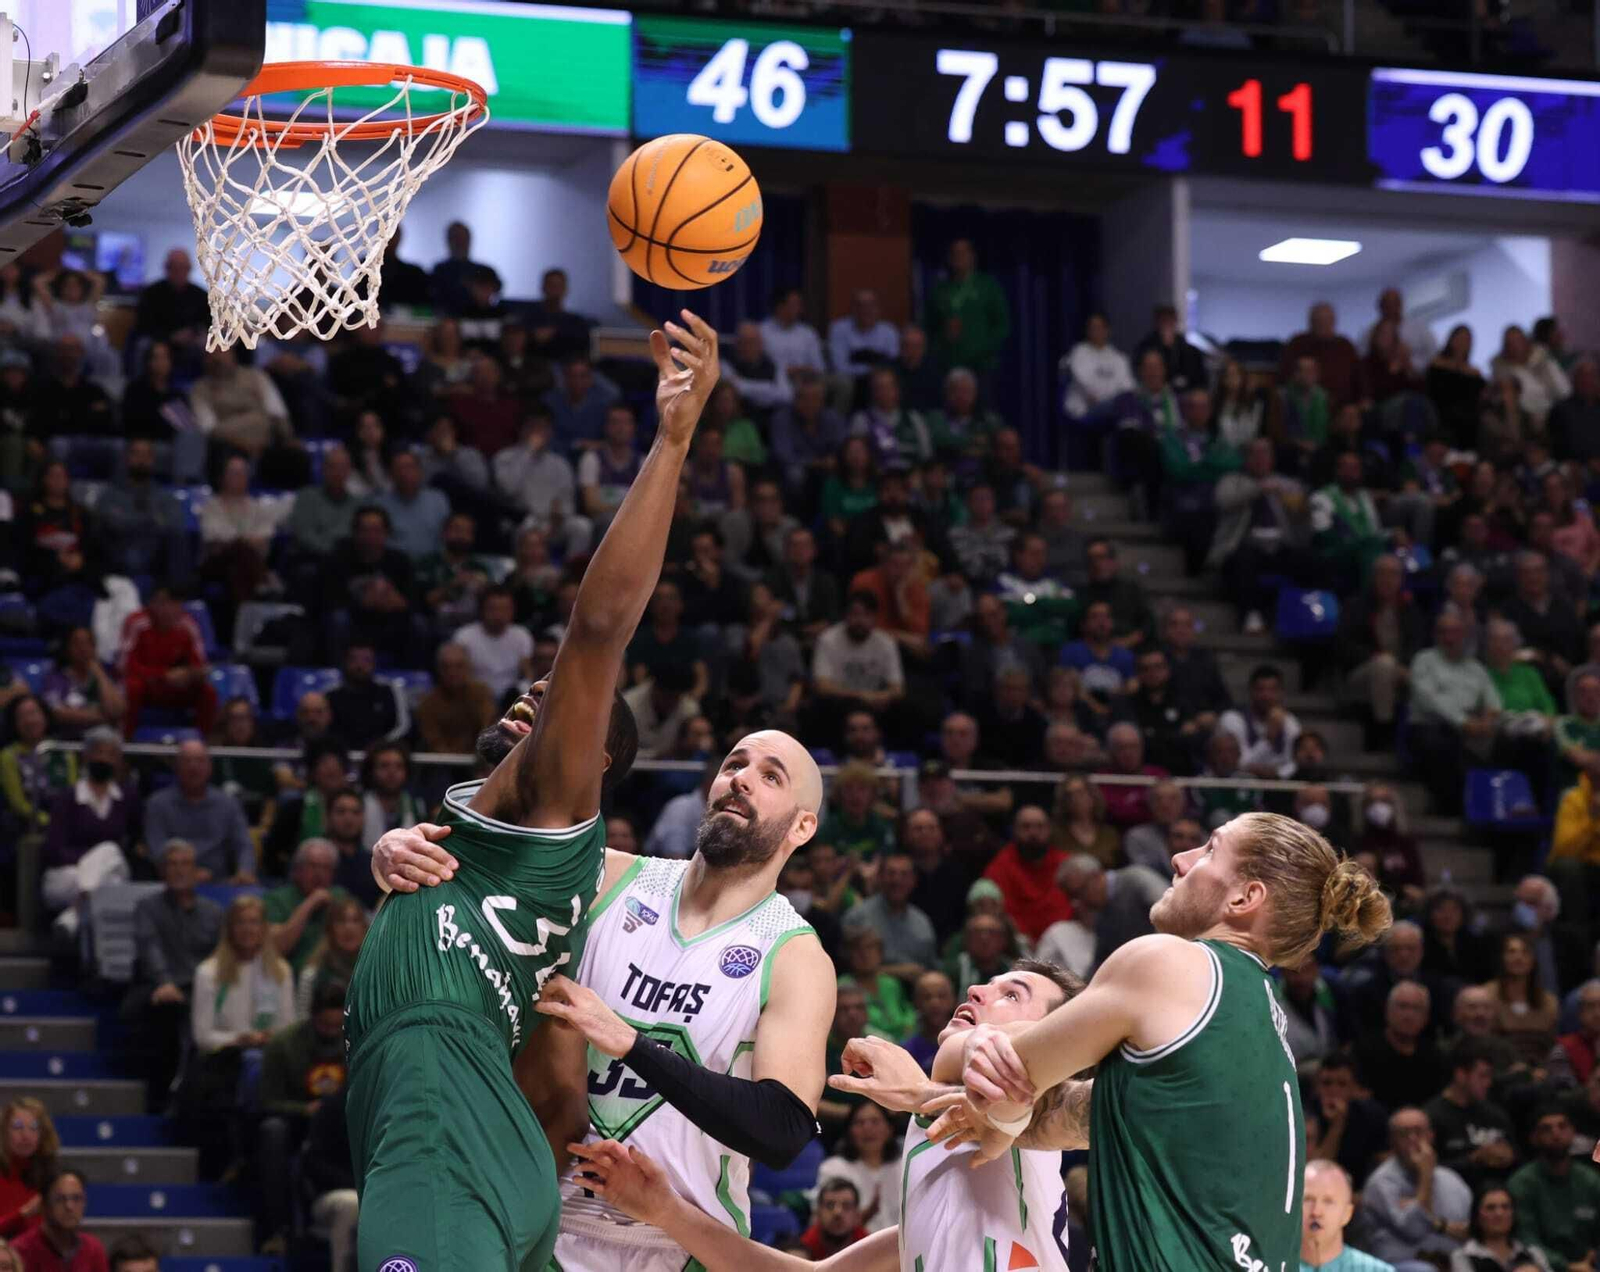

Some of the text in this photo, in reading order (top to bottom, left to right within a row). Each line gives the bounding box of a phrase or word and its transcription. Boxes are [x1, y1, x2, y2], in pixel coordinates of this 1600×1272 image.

[686, 38, 809, 130] 46
[936, 49, 1157, 154] 7:57
[1227, 78, 1314, 162] 11
[1420, 92, 1534, 183] 30
[620, 962, 712, 1023] TOFAŞ
